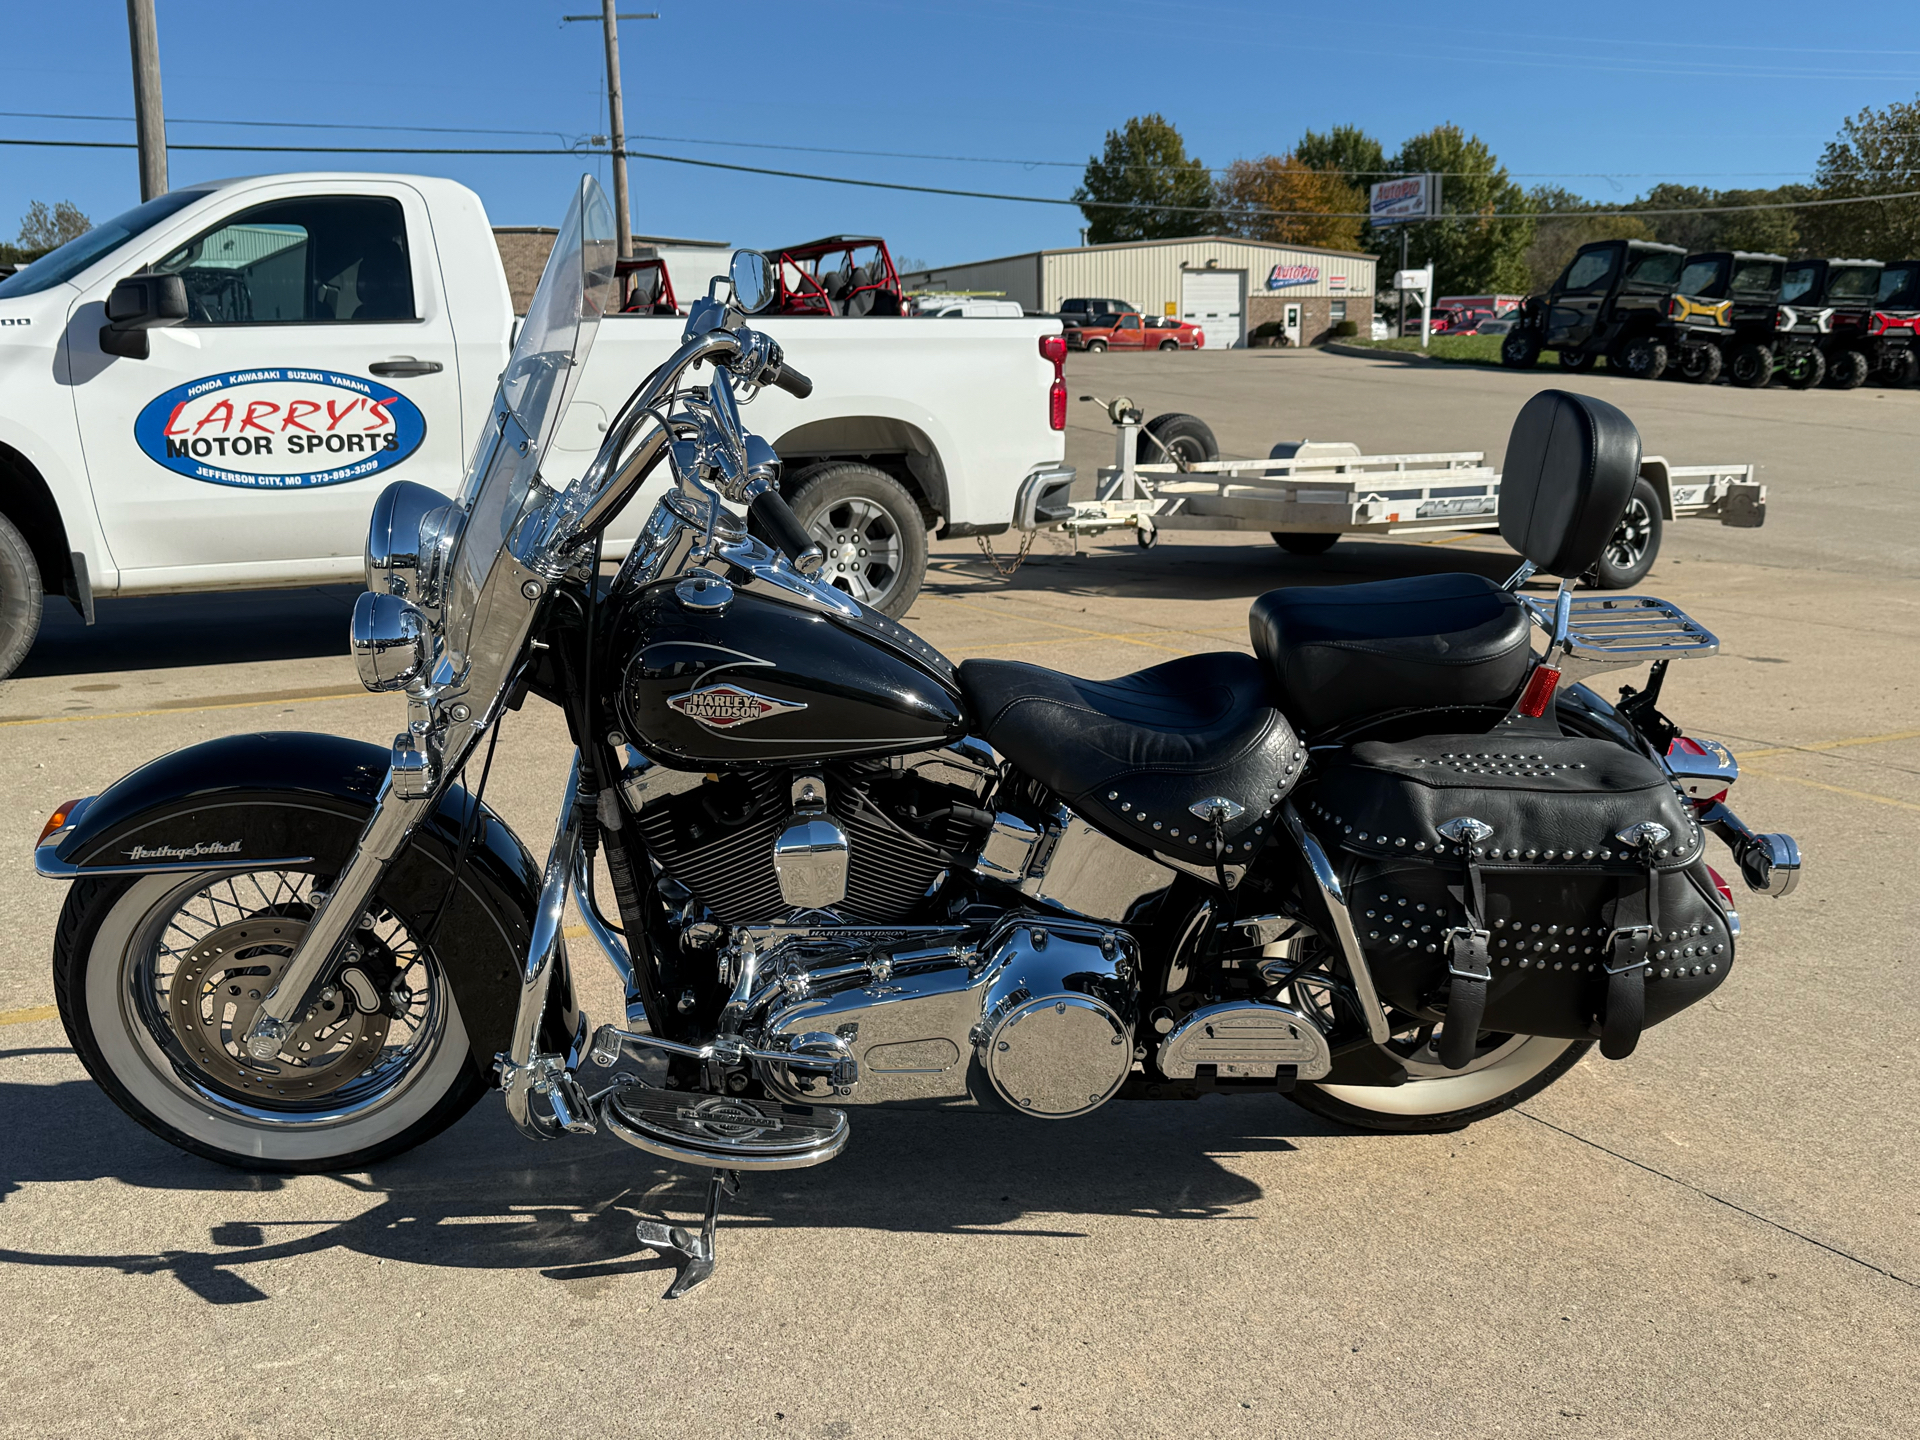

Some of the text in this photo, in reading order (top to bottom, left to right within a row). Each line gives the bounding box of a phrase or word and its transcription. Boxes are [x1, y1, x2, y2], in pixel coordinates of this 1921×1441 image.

[187, 370, 371, 397] HONDA KAWASAKI SUZUKI YAMAHA
[163, 396, 398, 436] LARRY'S
[165, 432, 400, 459] MOTOR SPORTS
[196, 459, 379, 488] JEFFERSON CITY, MO 573-893-3209
[685, 704, 761, 718] DAVIDSON
[691, 694, 759, 707] HARLEY-
